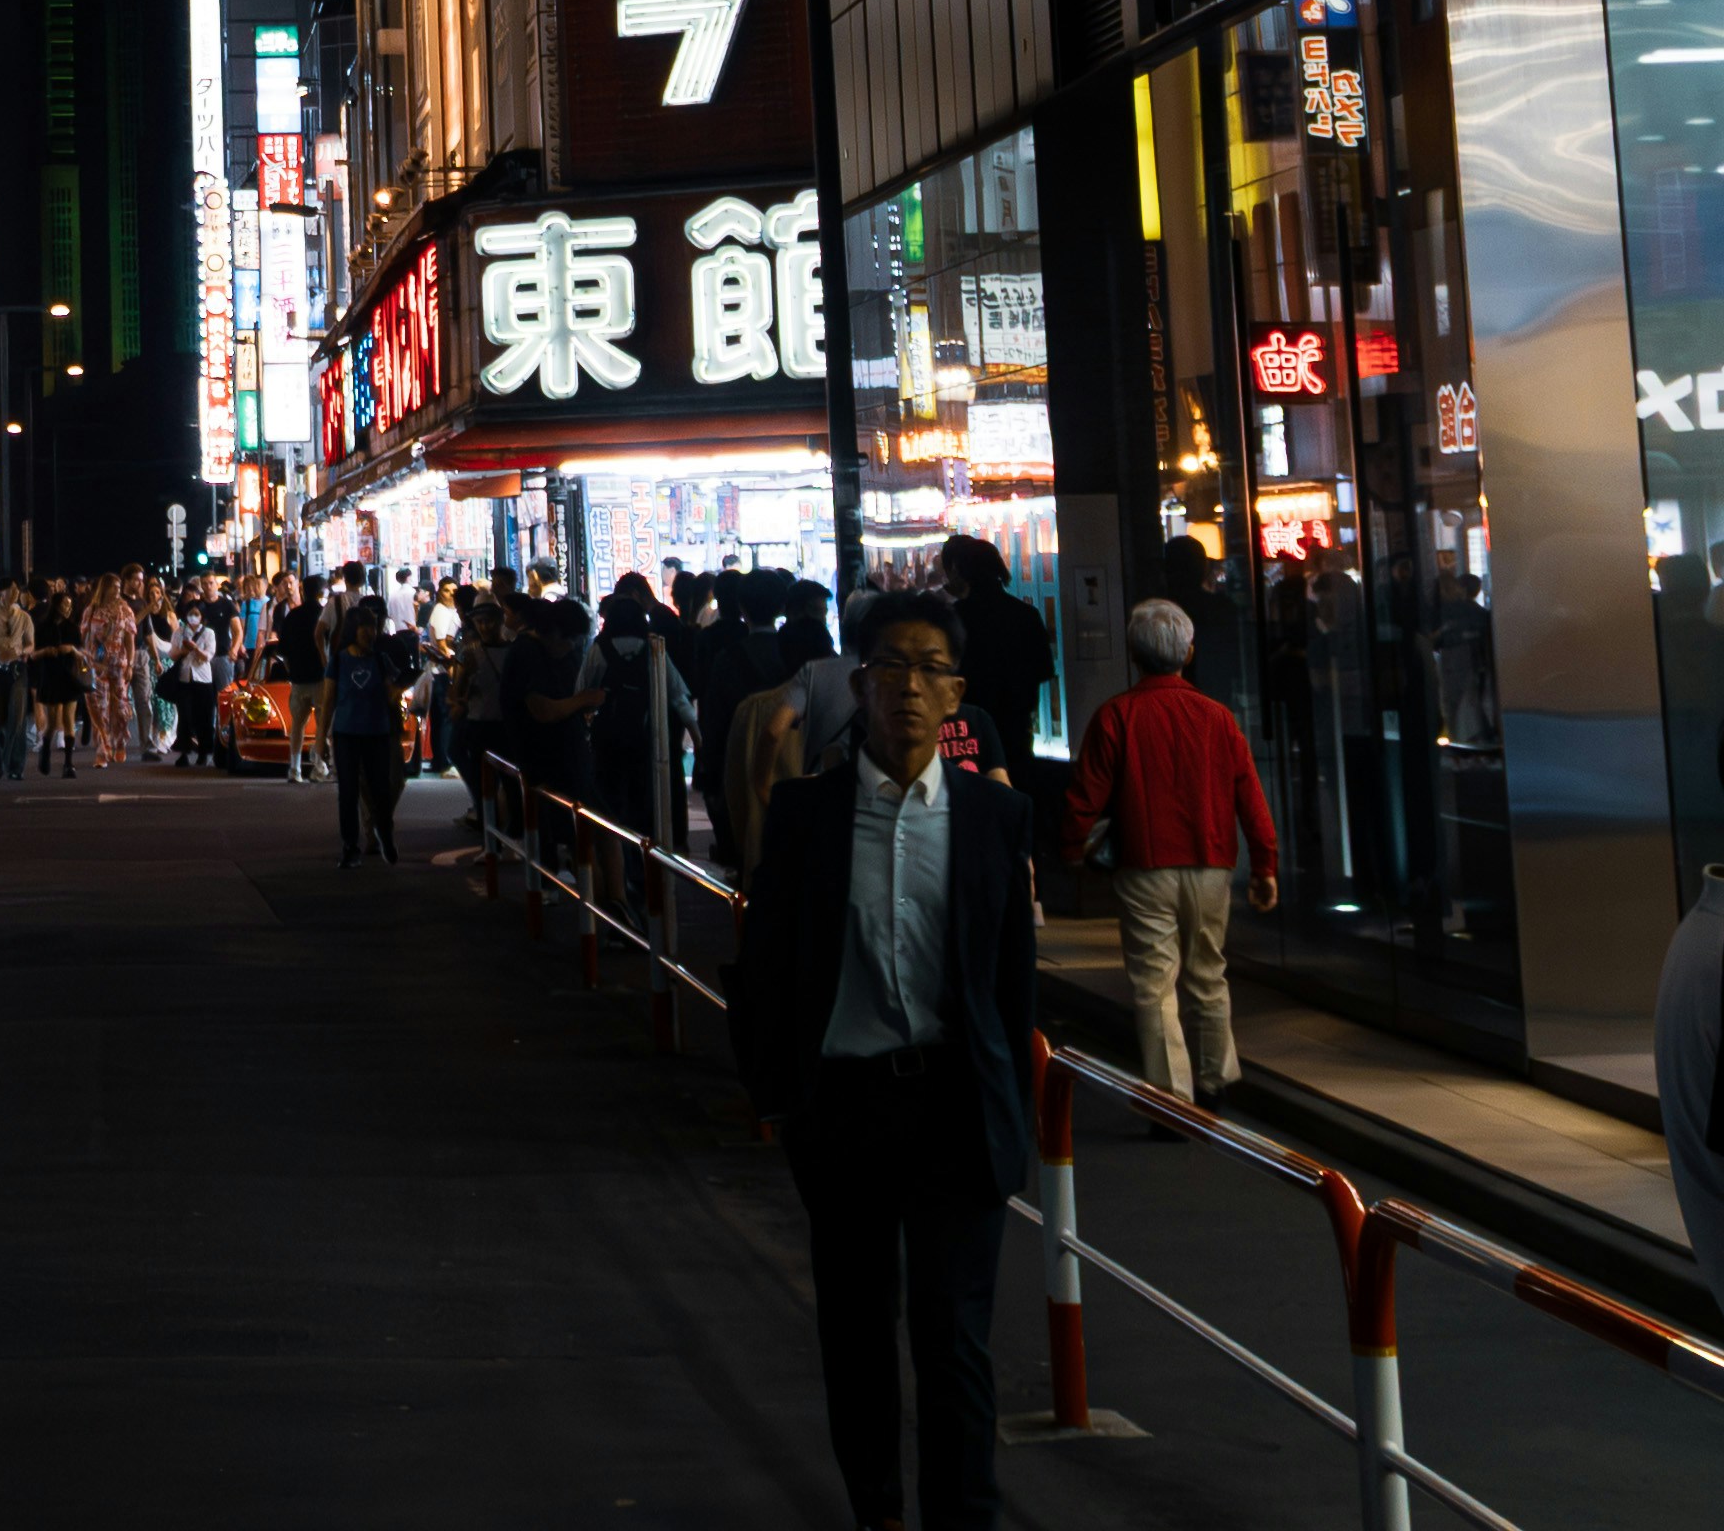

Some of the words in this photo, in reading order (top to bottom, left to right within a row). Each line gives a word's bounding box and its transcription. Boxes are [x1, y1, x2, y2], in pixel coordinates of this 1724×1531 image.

[195, 75, 219, 169] ダーツバー
